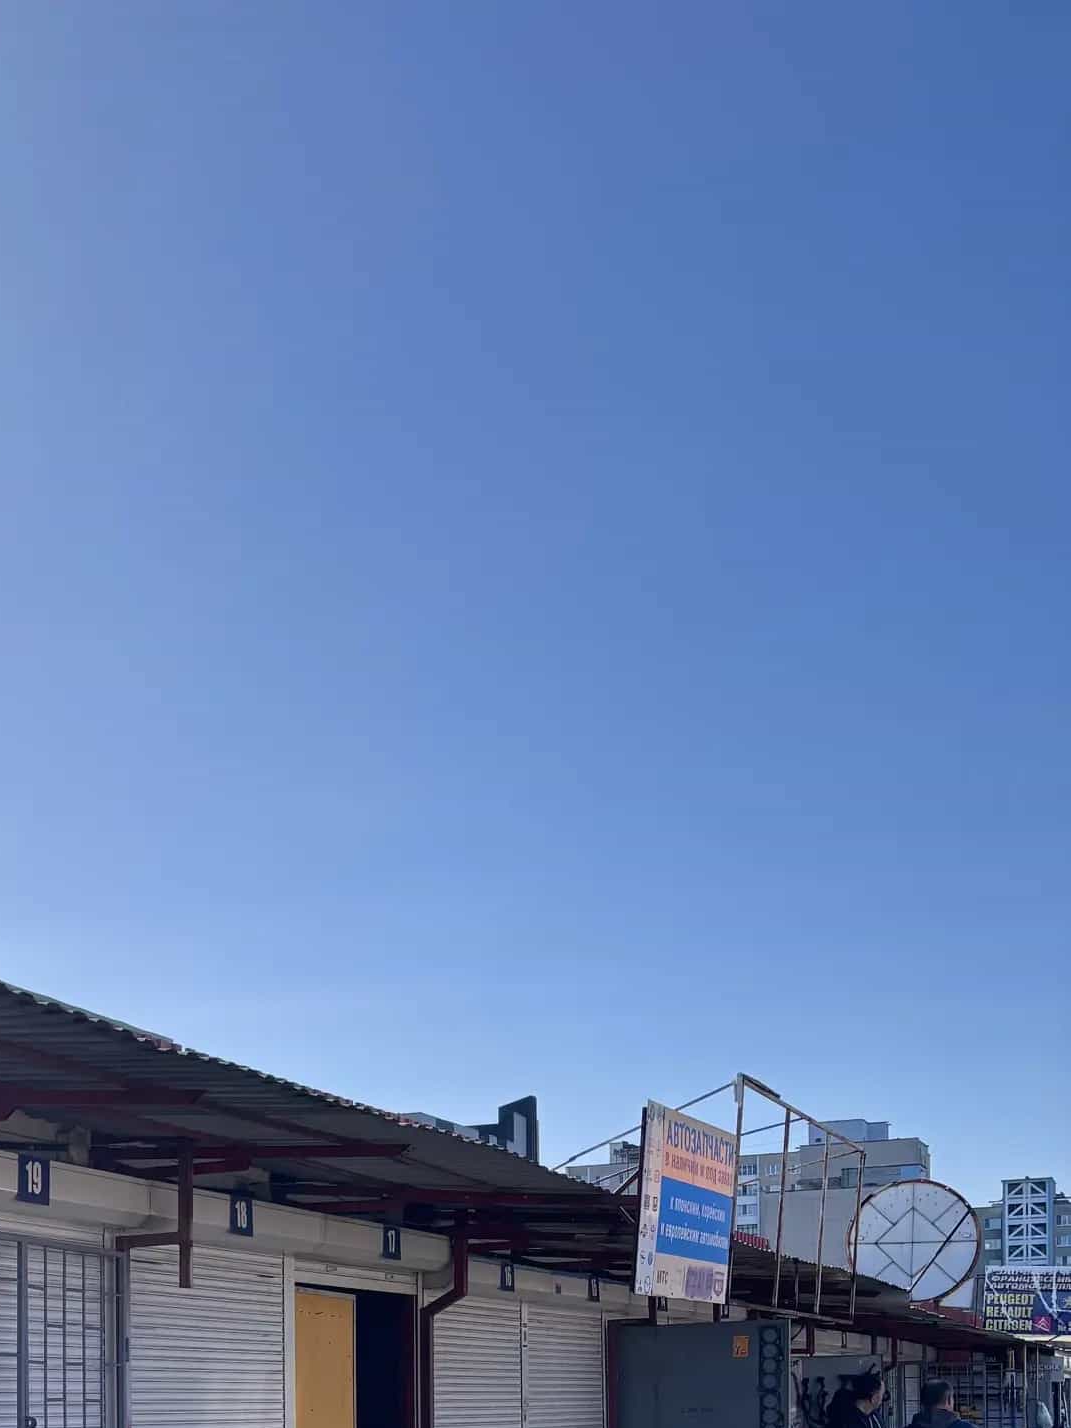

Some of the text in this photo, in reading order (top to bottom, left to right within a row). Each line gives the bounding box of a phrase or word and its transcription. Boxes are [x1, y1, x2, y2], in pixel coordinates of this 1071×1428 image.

[666, 1120, 735, 1167] АВТОЗАПЧАСТИ
[25, 1160, 42, 1194] 19
[235, 1200, 247, 1228] 18
[388, 1229, 395, 1253] 17
[986, 1293, 1036, 1305] PEUGEOT
